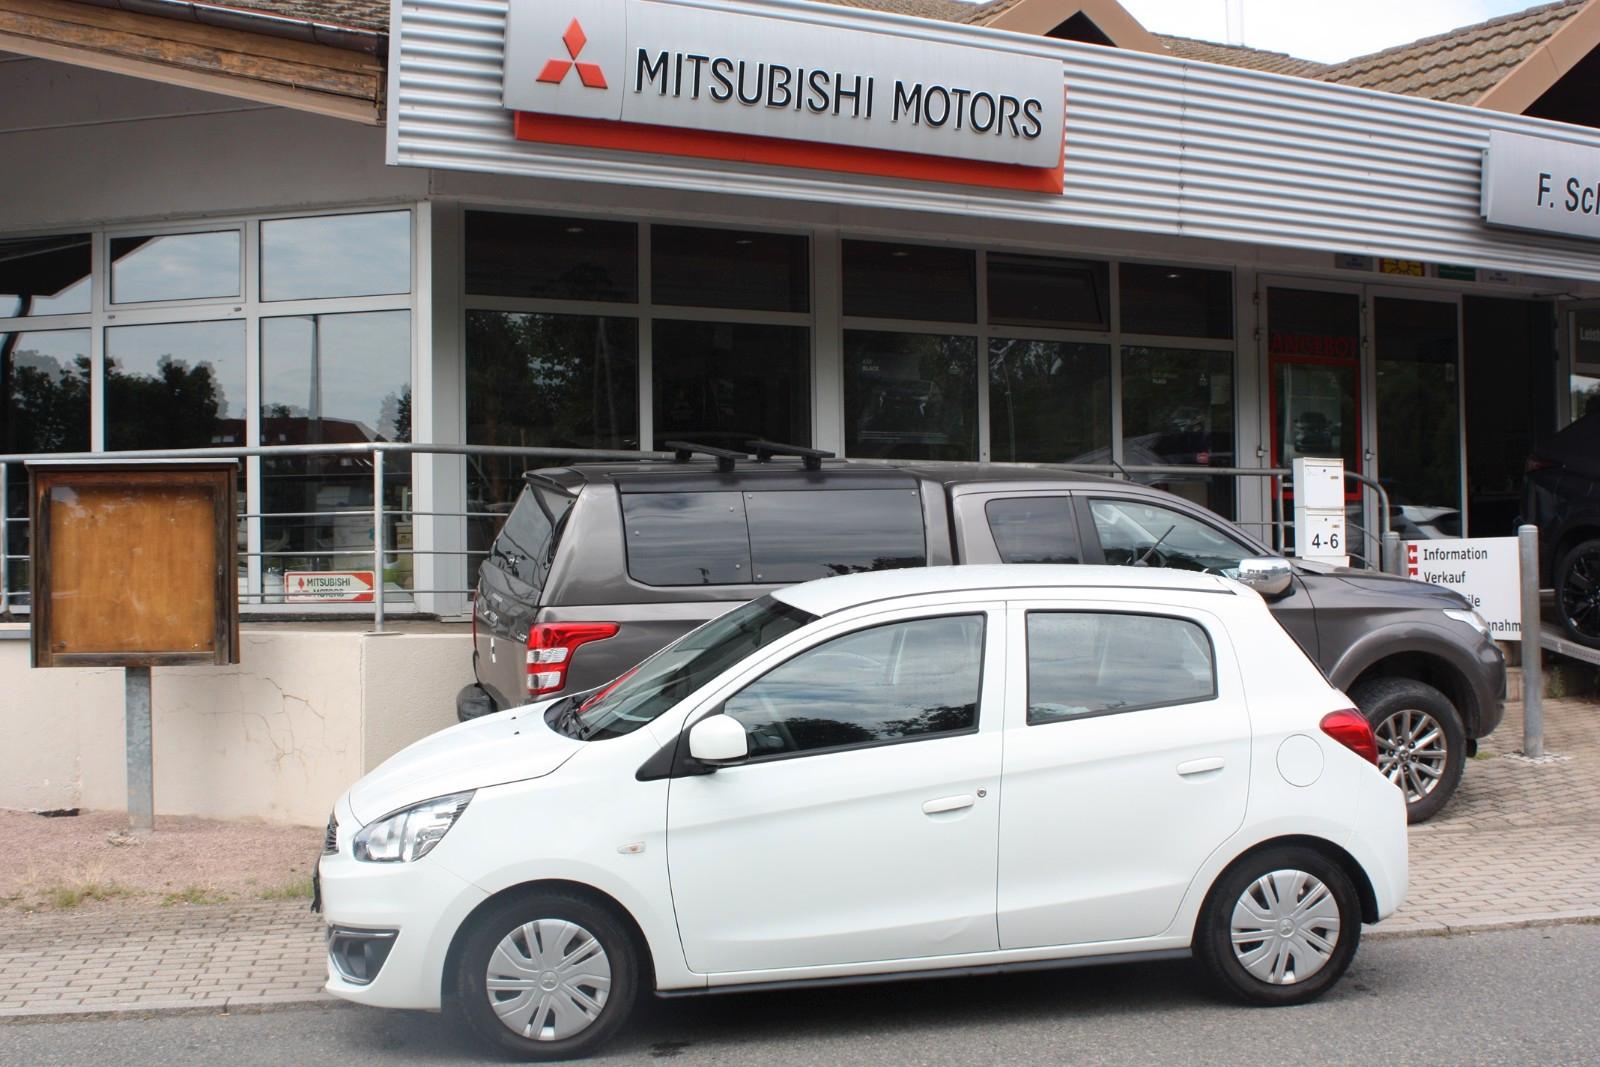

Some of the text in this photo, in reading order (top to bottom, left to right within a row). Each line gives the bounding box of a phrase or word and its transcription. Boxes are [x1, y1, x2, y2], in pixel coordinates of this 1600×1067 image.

[633, 47, 1043, 140] MITSUBISHI MOTORS
[1537, 172, 1554, 208] F.
[1312, 533, 1339, 549] 4-6
[1423, 547, 1488, 561] Information
[306, 577, 351, 587] MITSUBISHI
[1423, 571, 1466, 584] Verkauf
